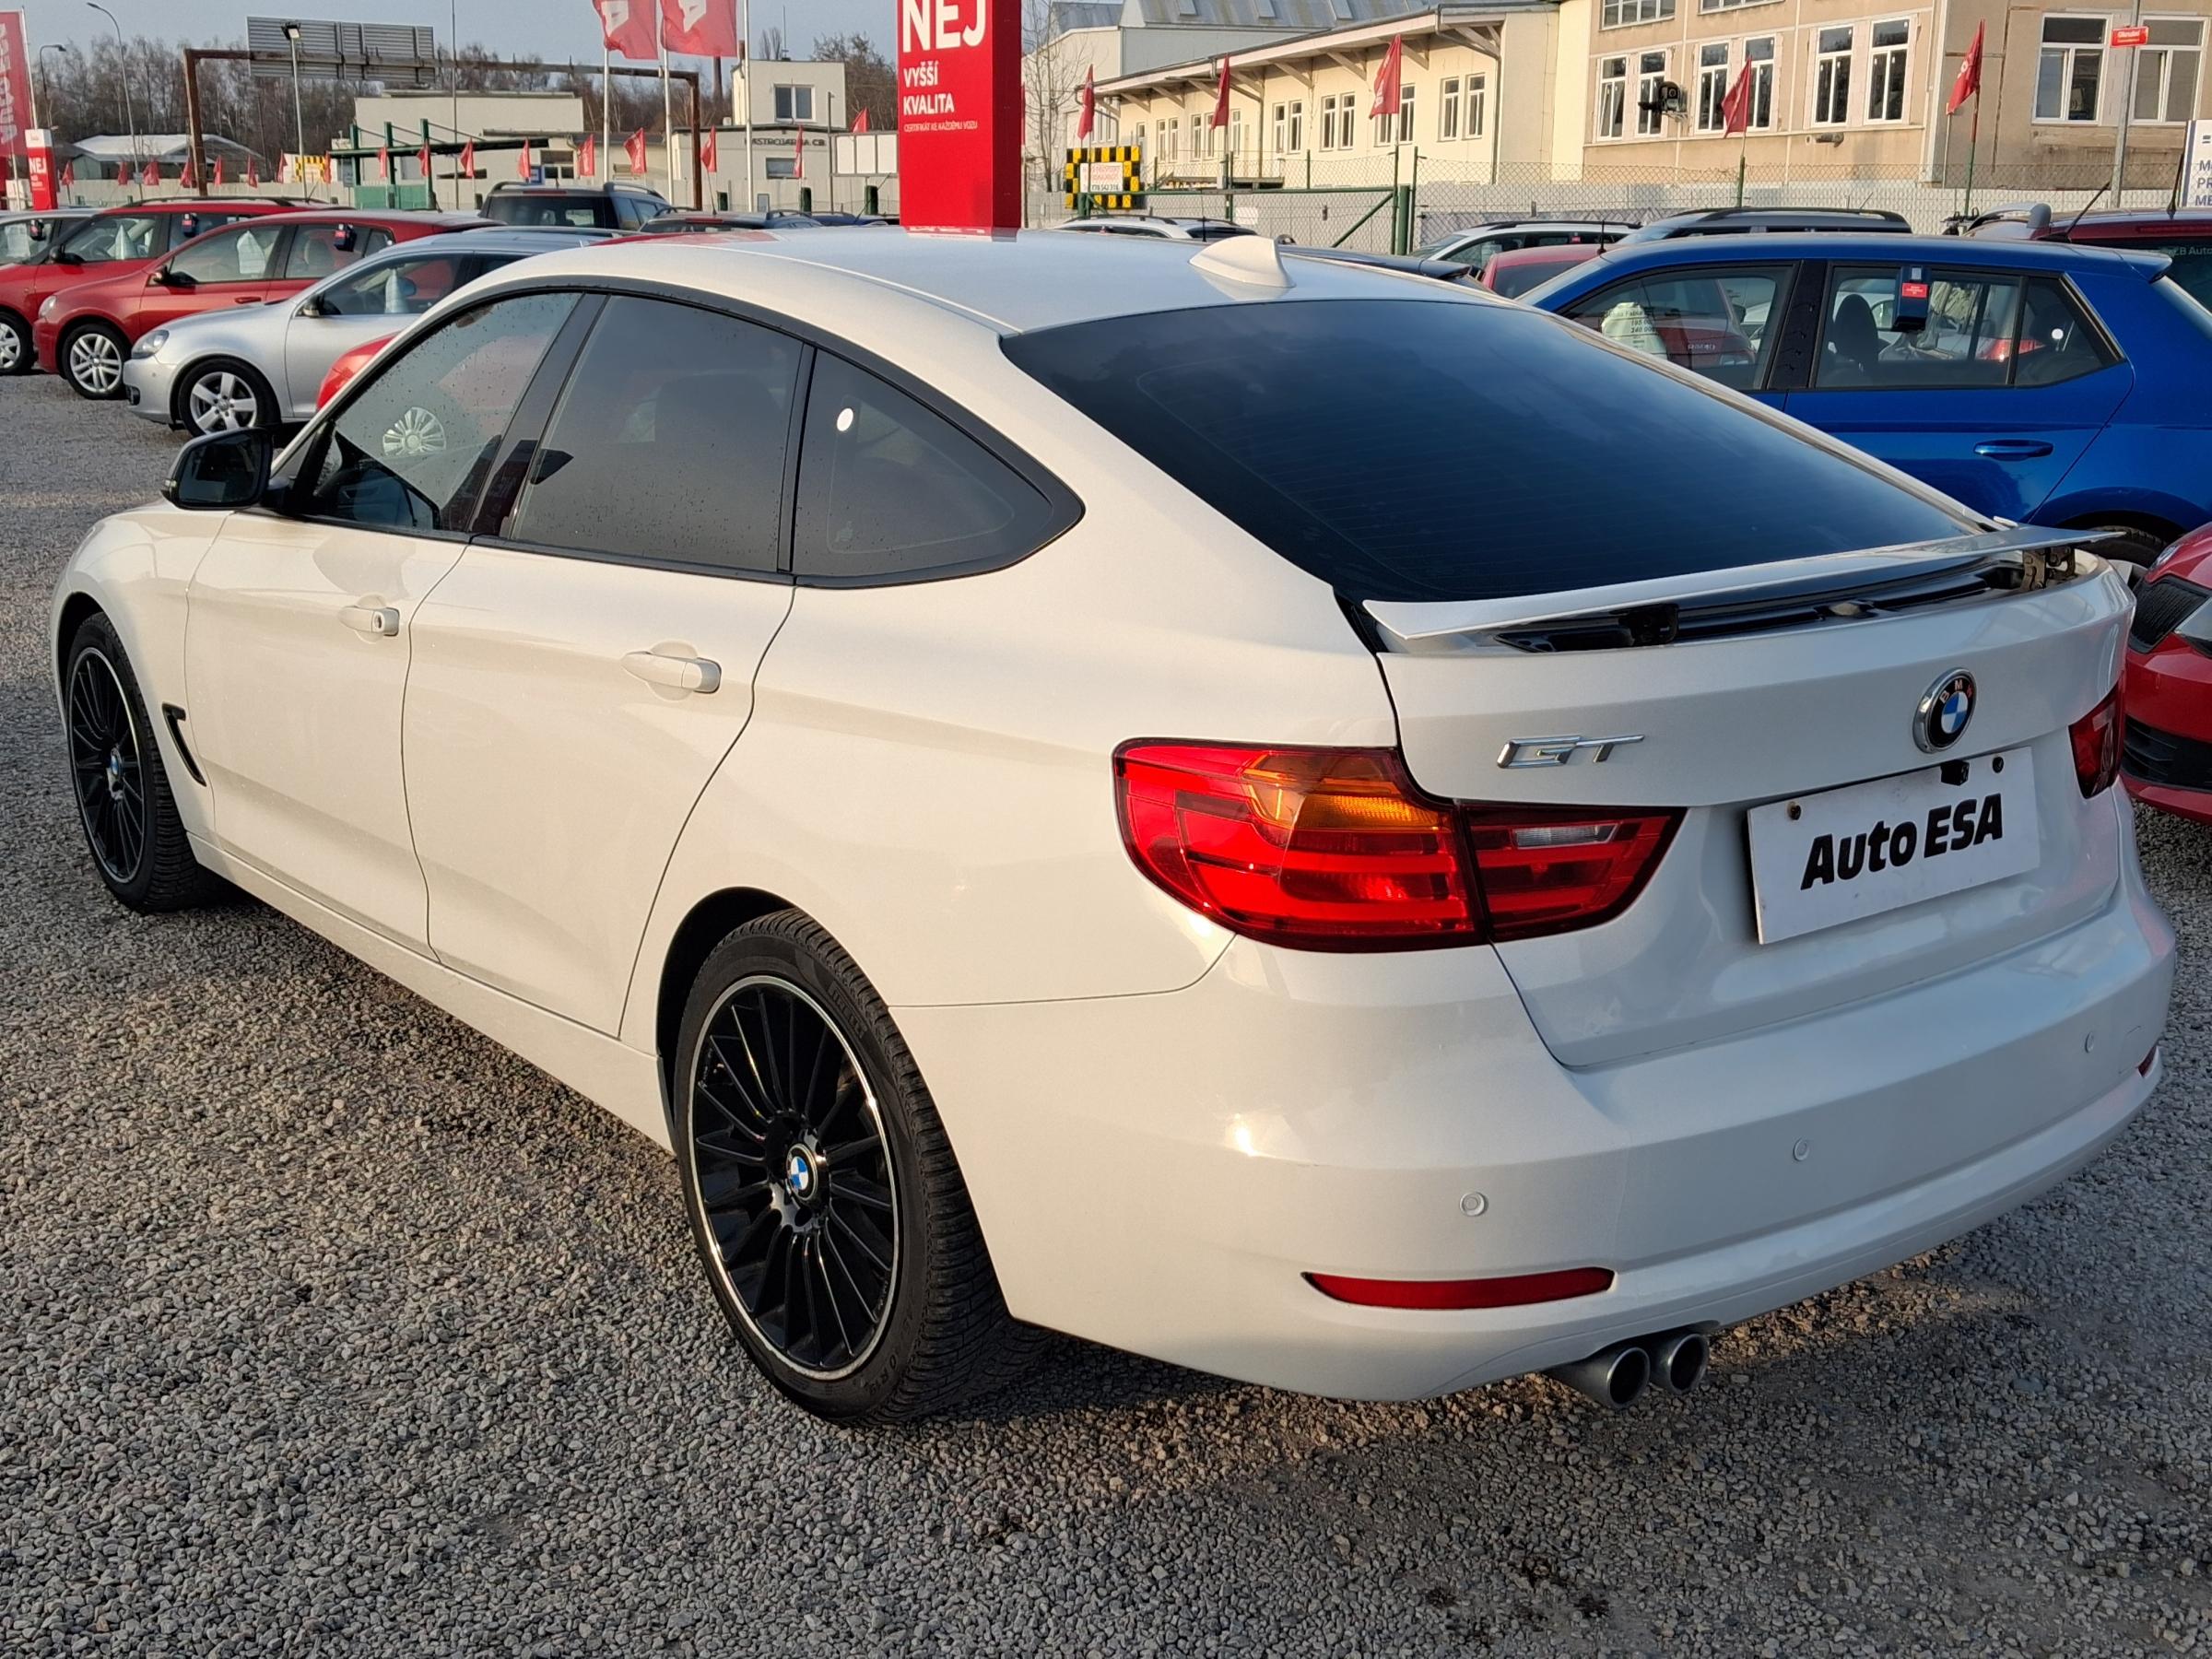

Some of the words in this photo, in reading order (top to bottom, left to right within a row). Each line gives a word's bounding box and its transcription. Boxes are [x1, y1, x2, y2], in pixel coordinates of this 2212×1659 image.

[903, 0, 986, 53] NEJ
[903, 60, 938, 88] VYŠŠÍ
[903, 92, 955, 115] KVALITA
[1939, 678, 1973, 704] BMW
[1497, 734, 1645, 769] GT
[1800, 820, 1918, 890] Auto
[1924, 793, 2003, 858] ESA
